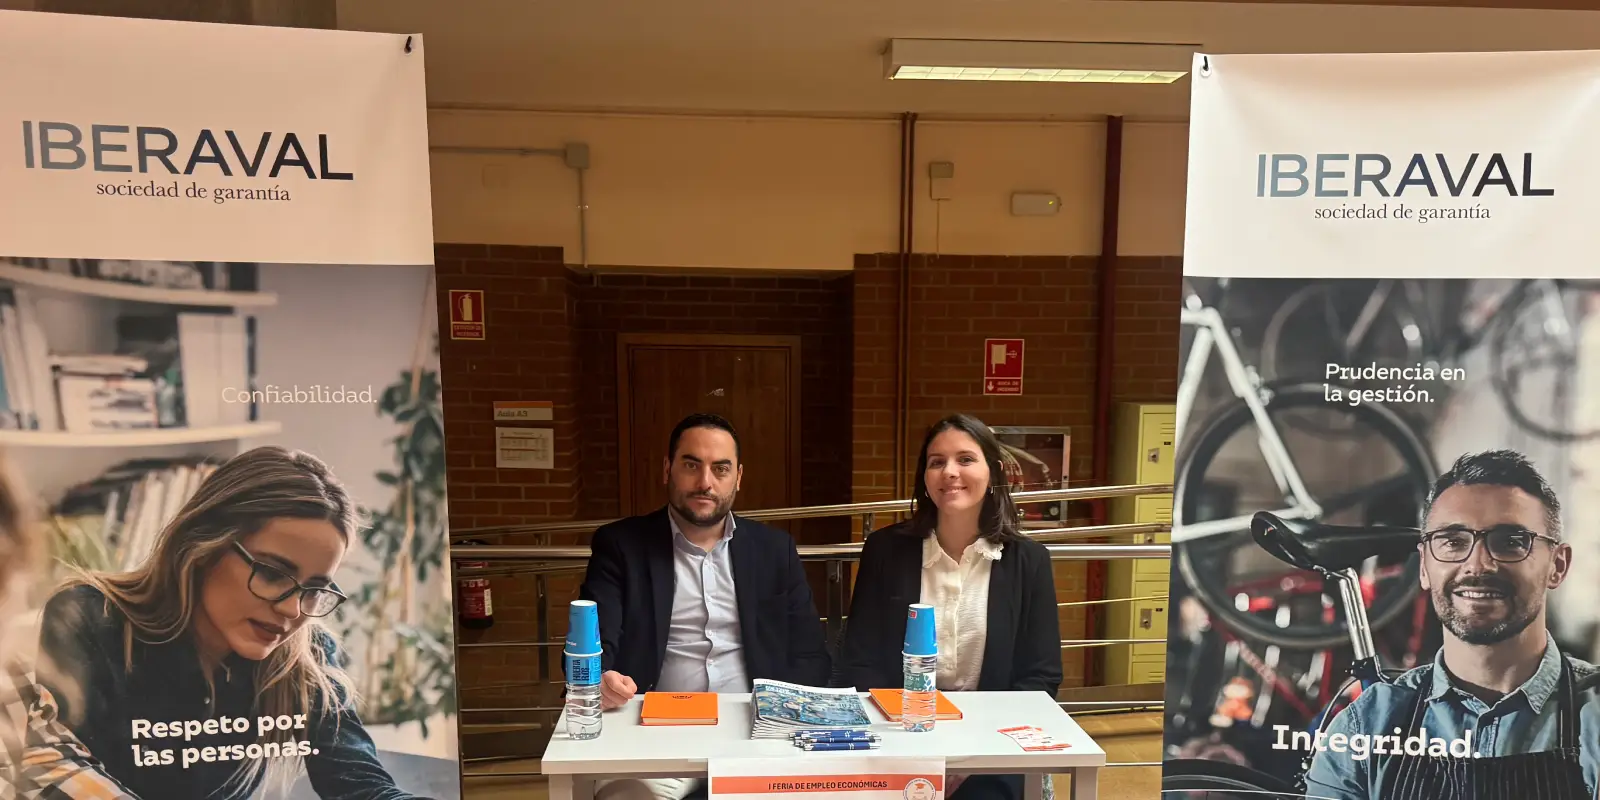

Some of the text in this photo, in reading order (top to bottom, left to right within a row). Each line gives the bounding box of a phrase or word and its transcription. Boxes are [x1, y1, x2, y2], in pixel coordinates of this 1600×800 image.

[22, 120, 354, 181] IBERAVAL
[1256, 152, 1555, 198] IBERAVAL
[96, 180, 291, 205] sociedad de garantía
[1314, 203, 1491, 224] sociedad de garantía
[1325, 362, 1466, 381] Prudencia en
[221, 384, 378, 404] Confiabilidad.
[1322, 384, 1435, 407] la gestión.
[131, 713, 308, 742] Respeto por
[131, 740, 320, 769] las personas.
[1271, 725, 1482, 760] Integridad.
[795, 782, 805, 790] DE
[806, 781, 836, 789] EMPLEO
[837, 779, 888, 789] ECONÓMICAS
